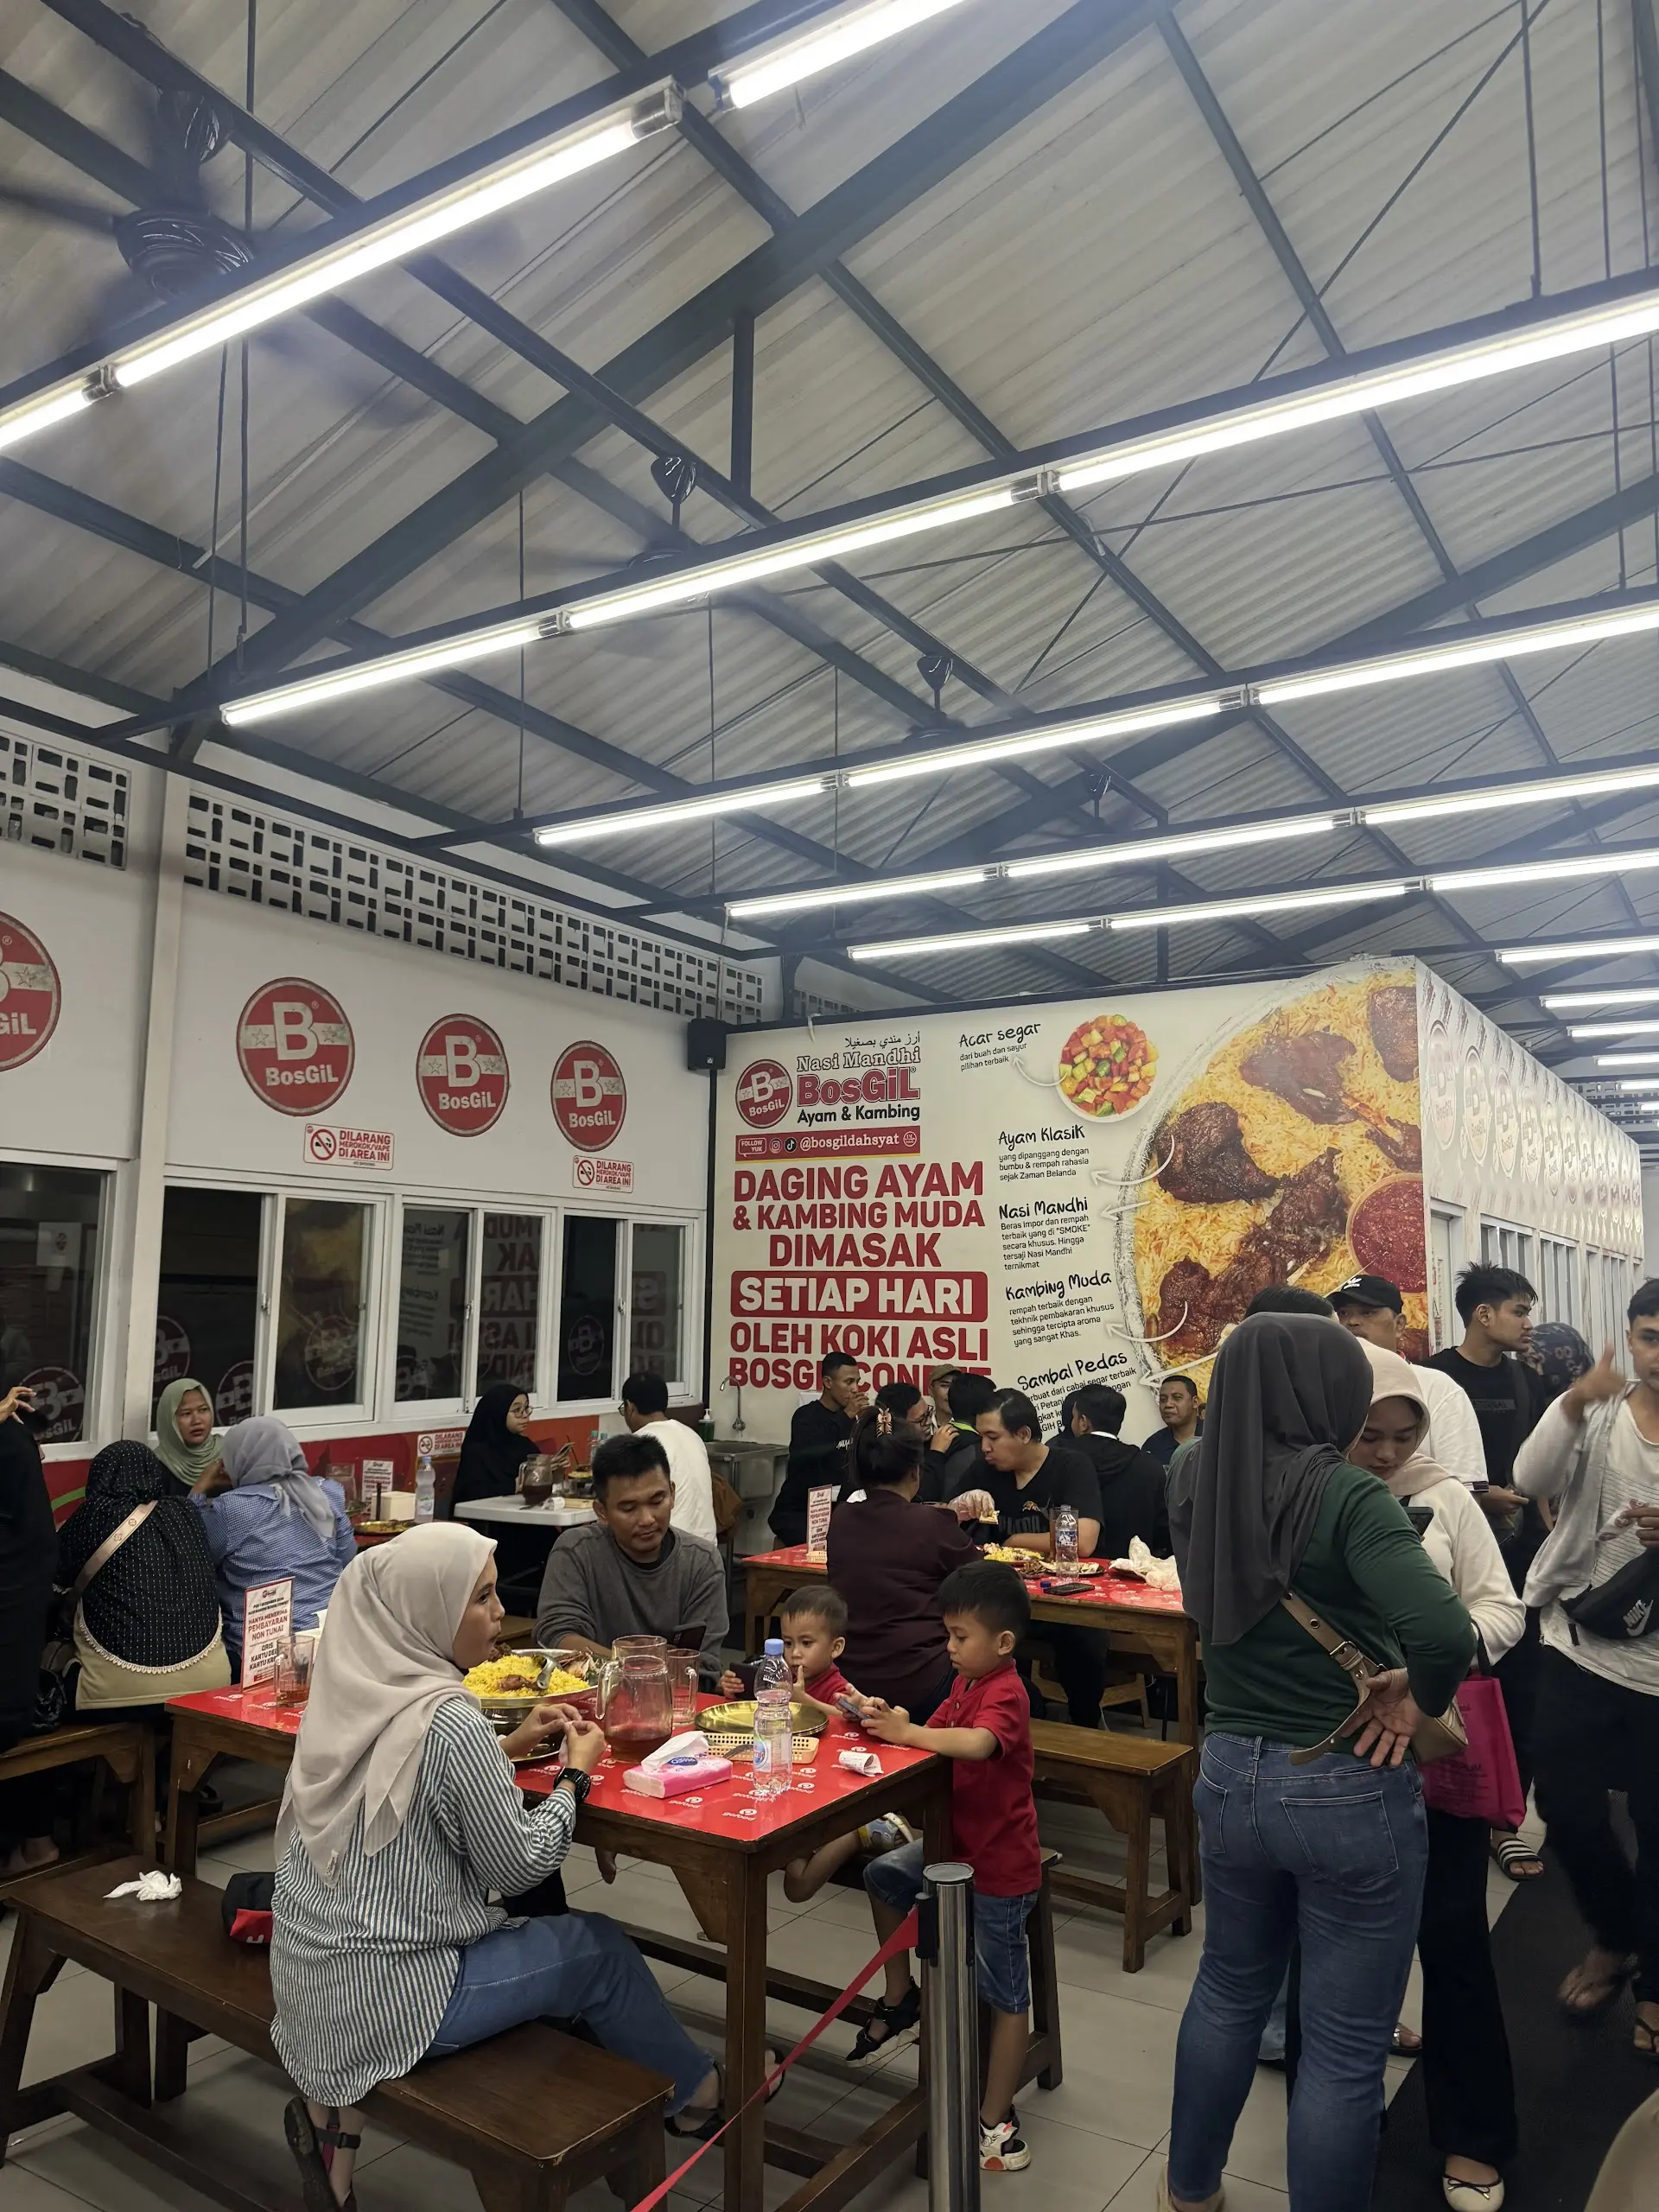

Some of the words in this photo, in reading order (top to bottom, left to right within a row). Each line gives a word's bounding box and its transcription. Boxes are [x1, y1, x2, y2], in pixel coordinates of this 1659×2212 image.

[273, 1001, 319, 1060] B
[959, 1033, 993, 1047] Acar
[997, 1023, 1041, 1044] segar
[445, 1035, 481, 1087] B
[797, 1052, 839, 1071] Nasi
[843, 1046, 921, 1069] Mandhi
[960, 1052, 973, 1061] dari
[974, 1049, 991, 1058] buah
[1007, 1043, 1027, 1052] sayur
[961, 1062, 983, 1071] pilihan
[984, 1056, 1009, 1066] terbaik
[265, 1065, 339, 1086] BosGiL
[573, 1060, 603, 1108] B
[751, 1071, 774, 1103] B
[438, 1091, 496, 1109] BosGiL
[748, 1099, 785, 1117] BosGiL
[568, 1110, 616, 1128] BosGiL
[798, 1109, 837, 1127] Ayam
[842, 1106, 852, 1120] &
[855, 1103, 920, 1122] Kambing
[339, 1130, 391, 1145] DILARANG
[800, 1133, 899, 1151] @bosgildahsyat
[998, 1131, 1036, 1151] Ayam
[338, 1147, 348, 1158] DI
[349, 1149, 375, 1160] AREA
[377, 1152, 390, 1161] INI
[999, 1154, 1016, 1162] yang
[1018, 1150, 1060, 1160] dipanggang
[1062, 1147, 1089, 1156] dengan
[596, 1160, 631, 1173] DILARANG
[1033, 1160, 1060, 1168] rempah
[604, 1176, 621, 1185] AREA
[734, 1166, 868, 1202] DAGING
[874, 1161, 983, 1198] AYAM
[1000, 1173, 1019, 1182] sejak
[1046, 1168, 1077, 1177] Belanda
[733, 1205, 752, 1230] &
[757, 1202, 887, 1230] KAMBING
[894, 1200, 985, 1228] MUDA
[999, 1204, 1030, 1219] Nasi
[1034, 1197, 1088, 1216] Mandhi
[1061, 1214, 1089, 1224] rempah
[1001, 1231, 1027, 1240] terbaik
[1028, 1230, 1046, 1239] yang
[1058, 1236, 1084, 1245] Hingga
[769, 1232, 942, 1268] DIMASAK
[1003, 1251, 1026, 1261] tersaji
[1027, 1249, 1044, 1258] Nasi
[1046, 1247, 1072, 1256] Mandhi
[1004, 1262, 1039, 1270] ternikmat
[1006, 1281, 1065, 1300] Kambing
[1068, 1270, 1112, 1289] Muda
[739, 1276, 870, 1313] SETIAP
[879, 1278, 973, 1315] HARI
[1009, 1305, 1036, 1315] rempah
[1038, 1300, 1064, 1311] terbaik
[1065, 1296, 1093, 1306] dengan
[1010, 1314, 1038, 1325] tekhnik
[1039, 1307, 1085, 1322] pembakaran
[1086, 1303, 1115, 1313] khusus
[1012, 1325, 1046, 1336] sehingga
[1046, 1320, 1076, 1330] tercipta
[1077, 1316, 1101, 1325] aroma
[730, 1322, 812, 1354] OLEH
[821, 1324, 899, 1358] KOKI
[906, 1326, 988, 1361] ASLI
[1014, 1338, 1032, 1347] yang
[1033, 1333, 1058, 1344] sangat
[1060, 1330, 1082, 1339] Khas.
[729, 1357, 823, 1392] BOSGI
[1017, 1363, 1073, 1391] Sambal
[1075, 1352, 1128, 1376] Pedas
[1029, 1391, 1050, 1402] rbuat
[1051, 1386, 1065, 1395] dari
[1066, 1380, 1086, 1392] cabai
[1109, 1367, 1136, 1380] terbaik
[248, 1614, 264, 1624] HANYA
[248, 1615, 288, 1633] PEMBAYARAN
[251, 1630, 265, 1641] NON
[265, 1625, 284, 1637] TUNAI
[251, 1651, 269, 1662] KARTU
